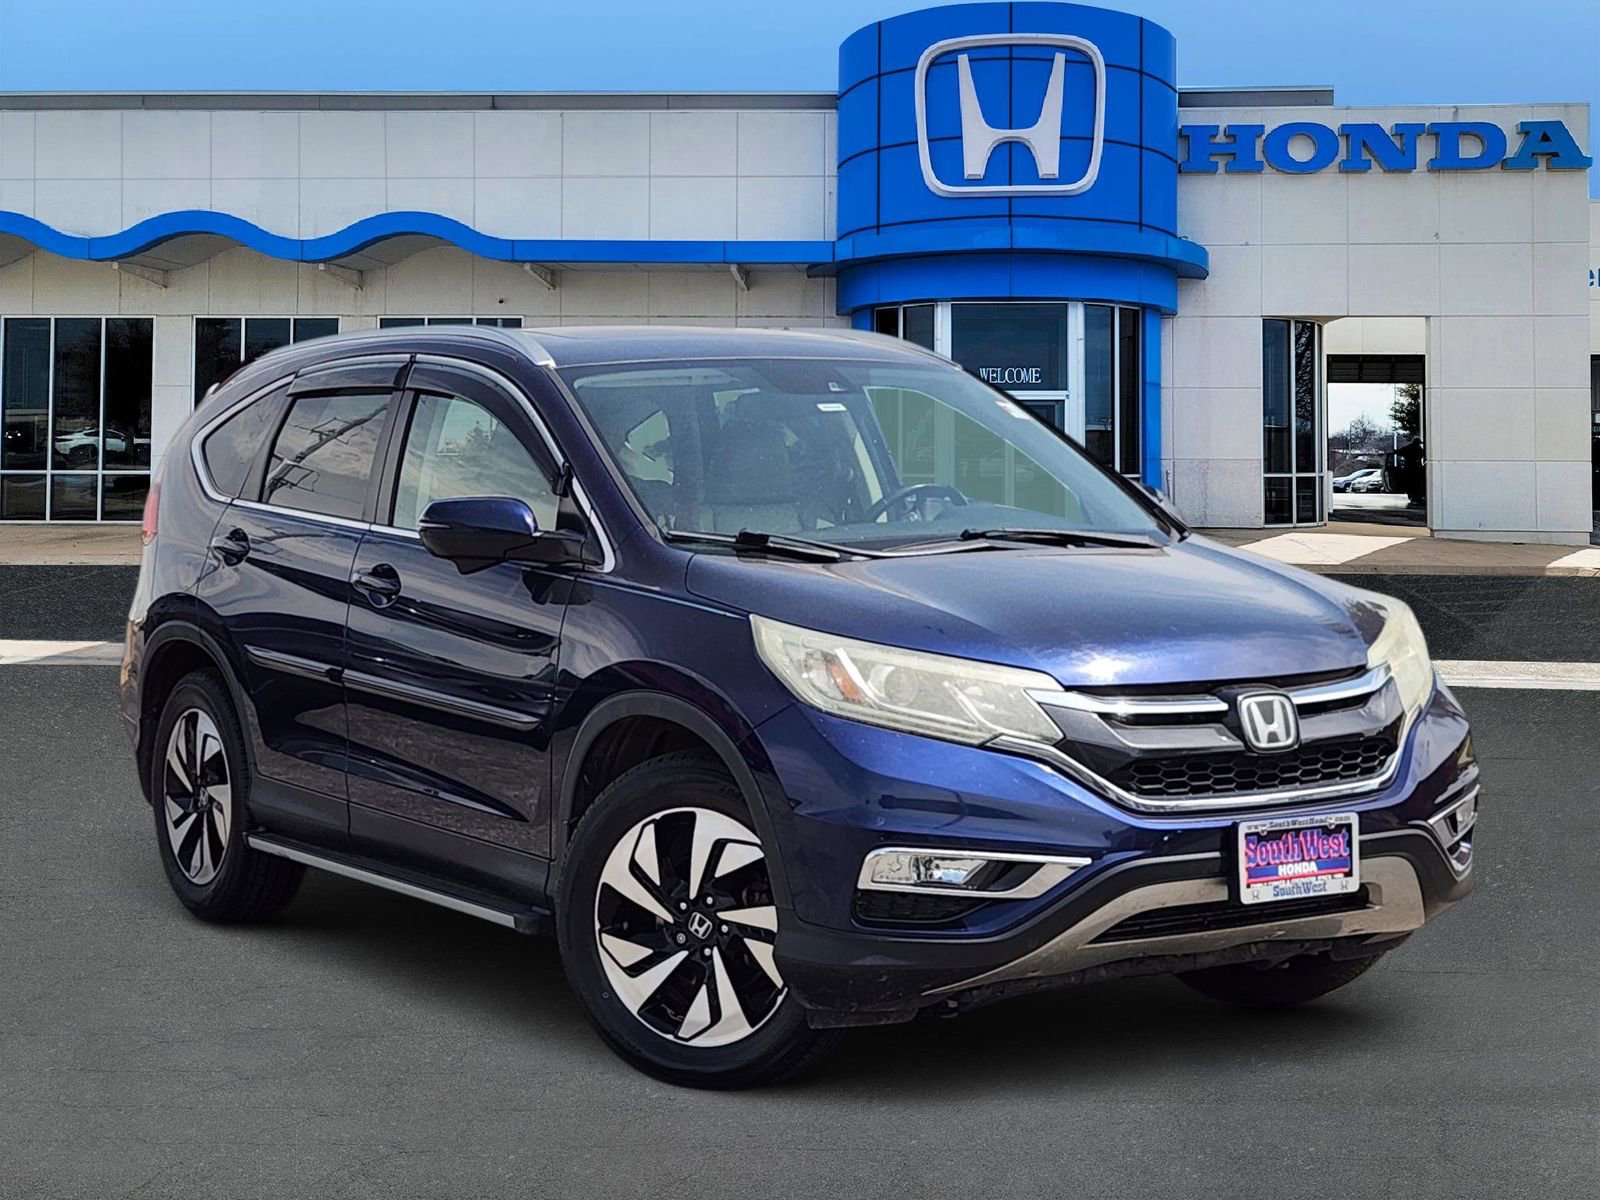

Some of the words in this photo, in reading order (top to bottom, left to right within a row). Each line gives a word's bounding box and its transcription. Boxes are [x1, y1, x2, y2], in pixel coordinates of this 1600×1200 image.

[1178, 121, 1592, 174] HONDA
[979, 367, 1041, 384] WELCOME
[1246, 815, 1351, 830] www.SouthWestHondcom
[1278, 861, 1318, 877] HONDA
